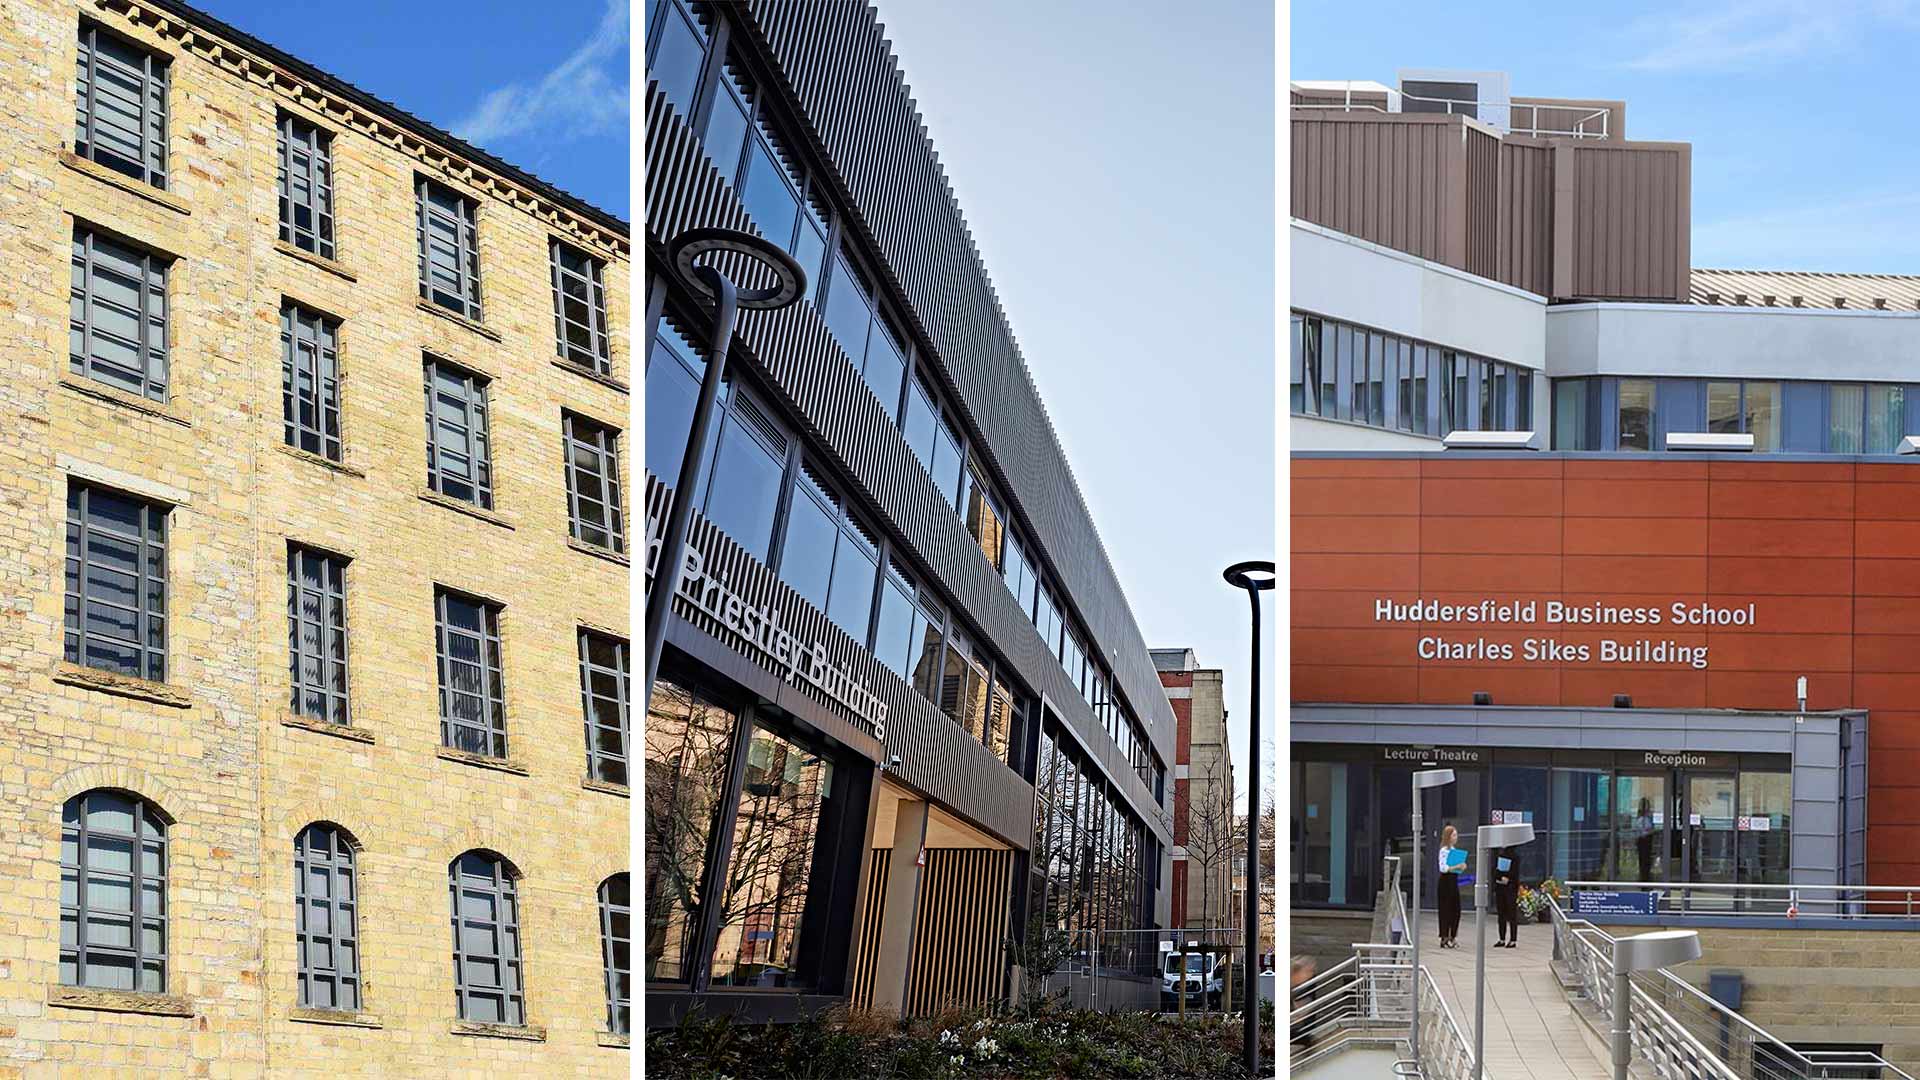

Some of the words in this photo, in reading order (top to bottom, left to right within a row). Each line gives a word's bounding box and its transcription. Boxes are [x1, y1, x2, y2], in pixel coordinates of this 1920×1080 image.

[1375, 599, 1536, 623] Huddersfield
[1546, 601, 1661, 625] Business
[1671, 602, 1755, 625] School
[674, 542, 804, 682] Priestley
[808, 641, 888, 739] Building
[1417, 637, 1513, 660] Charles
[1523, 638, 1590, 662] Sikes
[1600, 640, 1708, 668] Building
[1384, 747, 1429, 761] Lecture
[1433, 748, 1478, 762] Theatre
[1645, 752, 1706, 766] Reception
